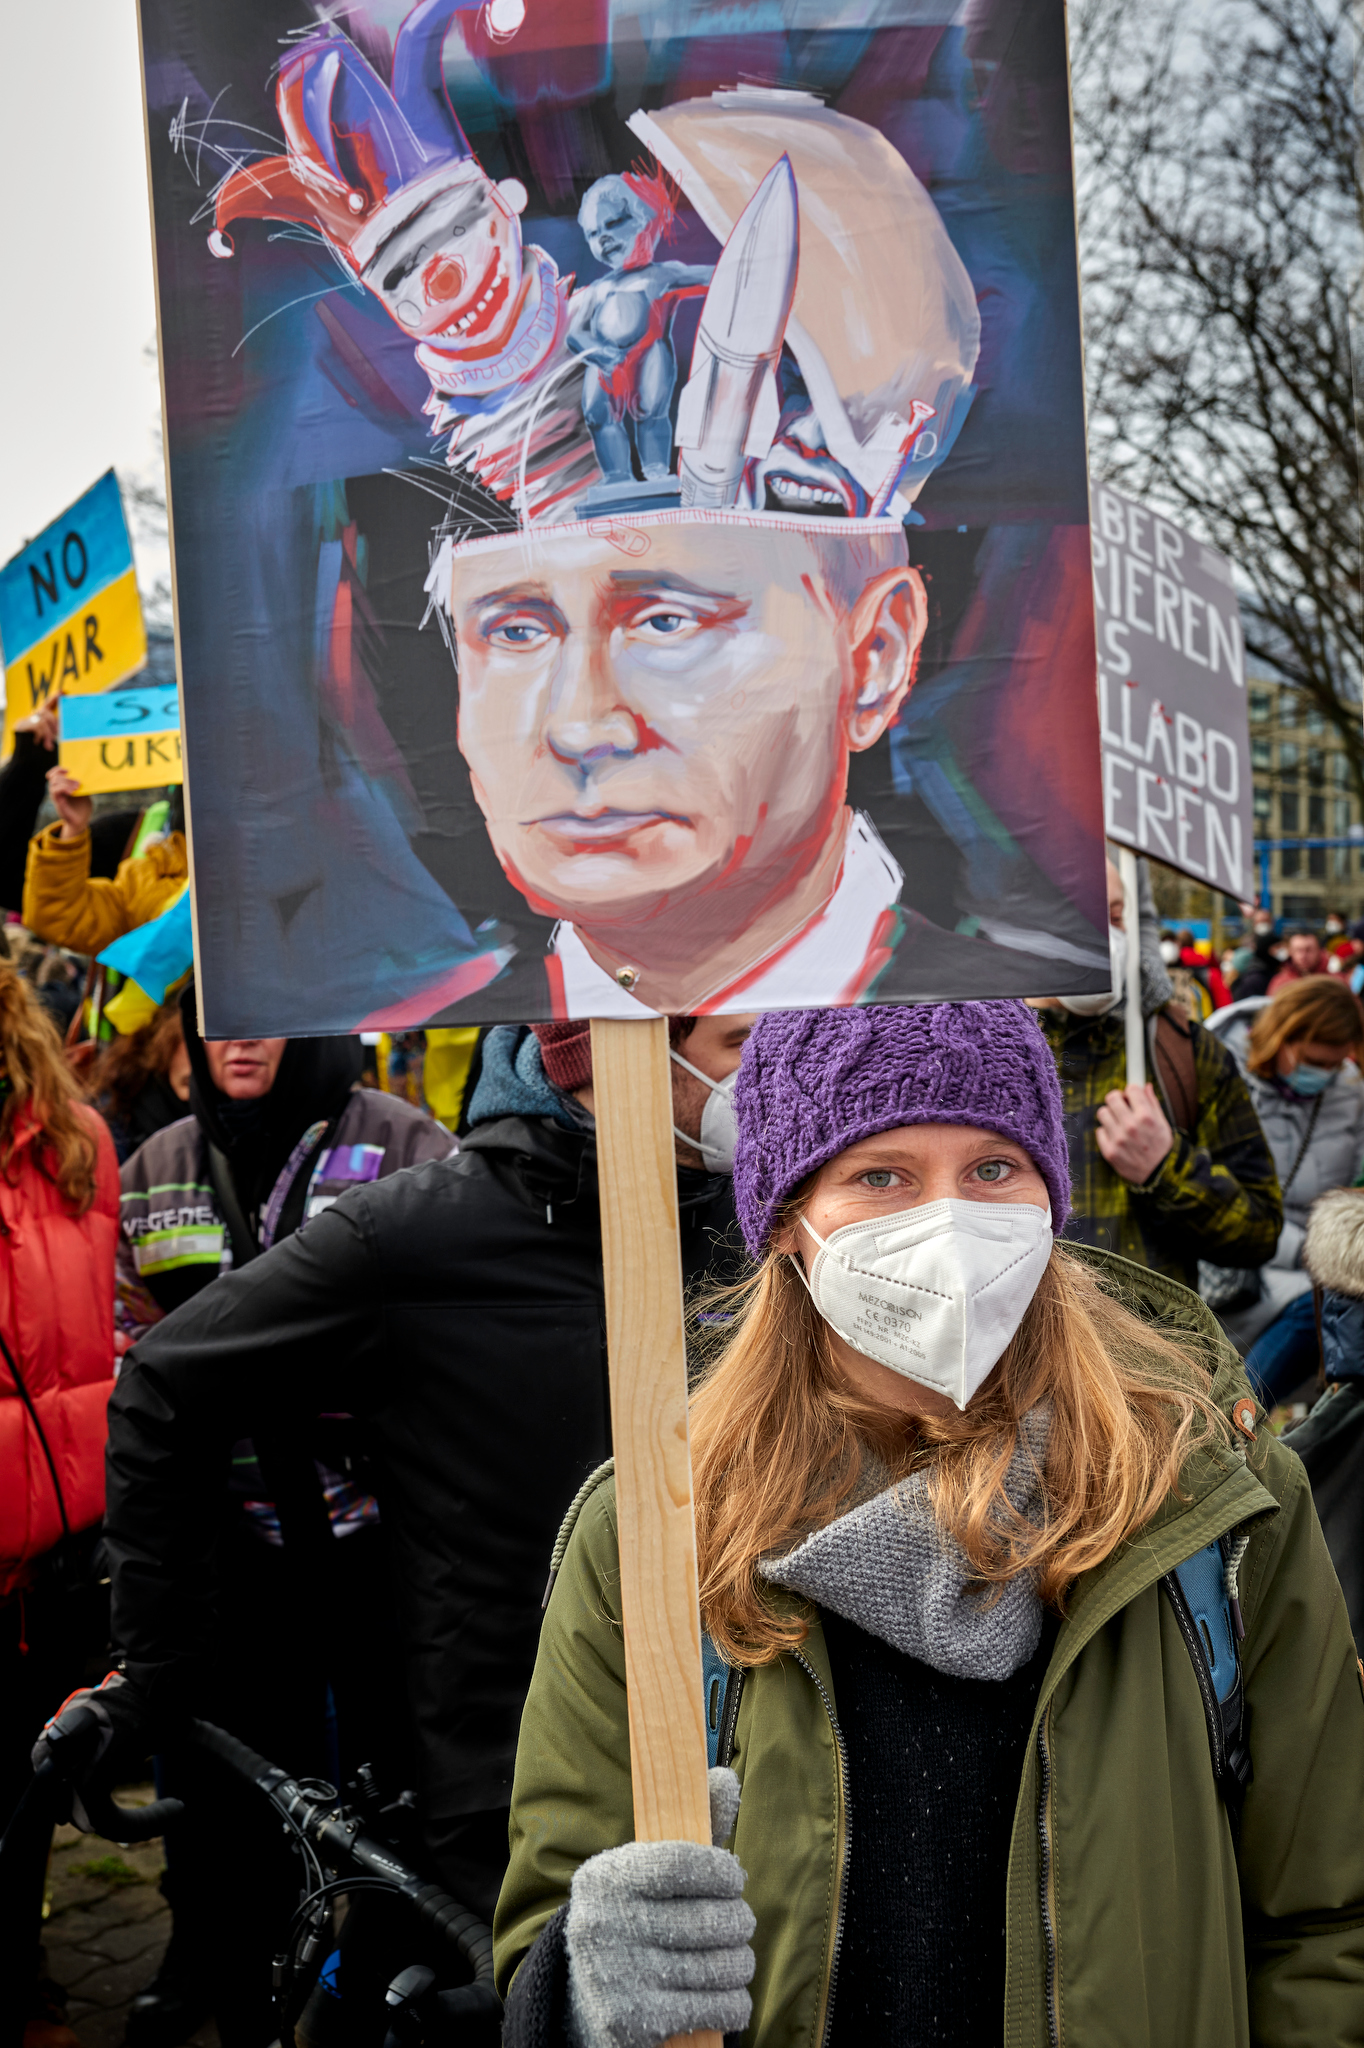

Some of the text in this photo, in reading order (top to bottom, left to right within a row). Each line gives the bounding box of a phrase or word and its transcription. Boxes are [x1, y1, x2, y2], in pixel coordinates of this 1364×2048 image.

[28, 530, 89, 618] NO
[1091, 485, 1185, 583] BER
[26, 613, 104, 709] WAR
[1097, 618, 1132, 676] S
[99, 736, 182, 771] UK
[1099, 673, 1240, 805] LLABO
[1103, 751, 1243, 893] EREN
[865, 1308, 911, 1333] CE 0370
